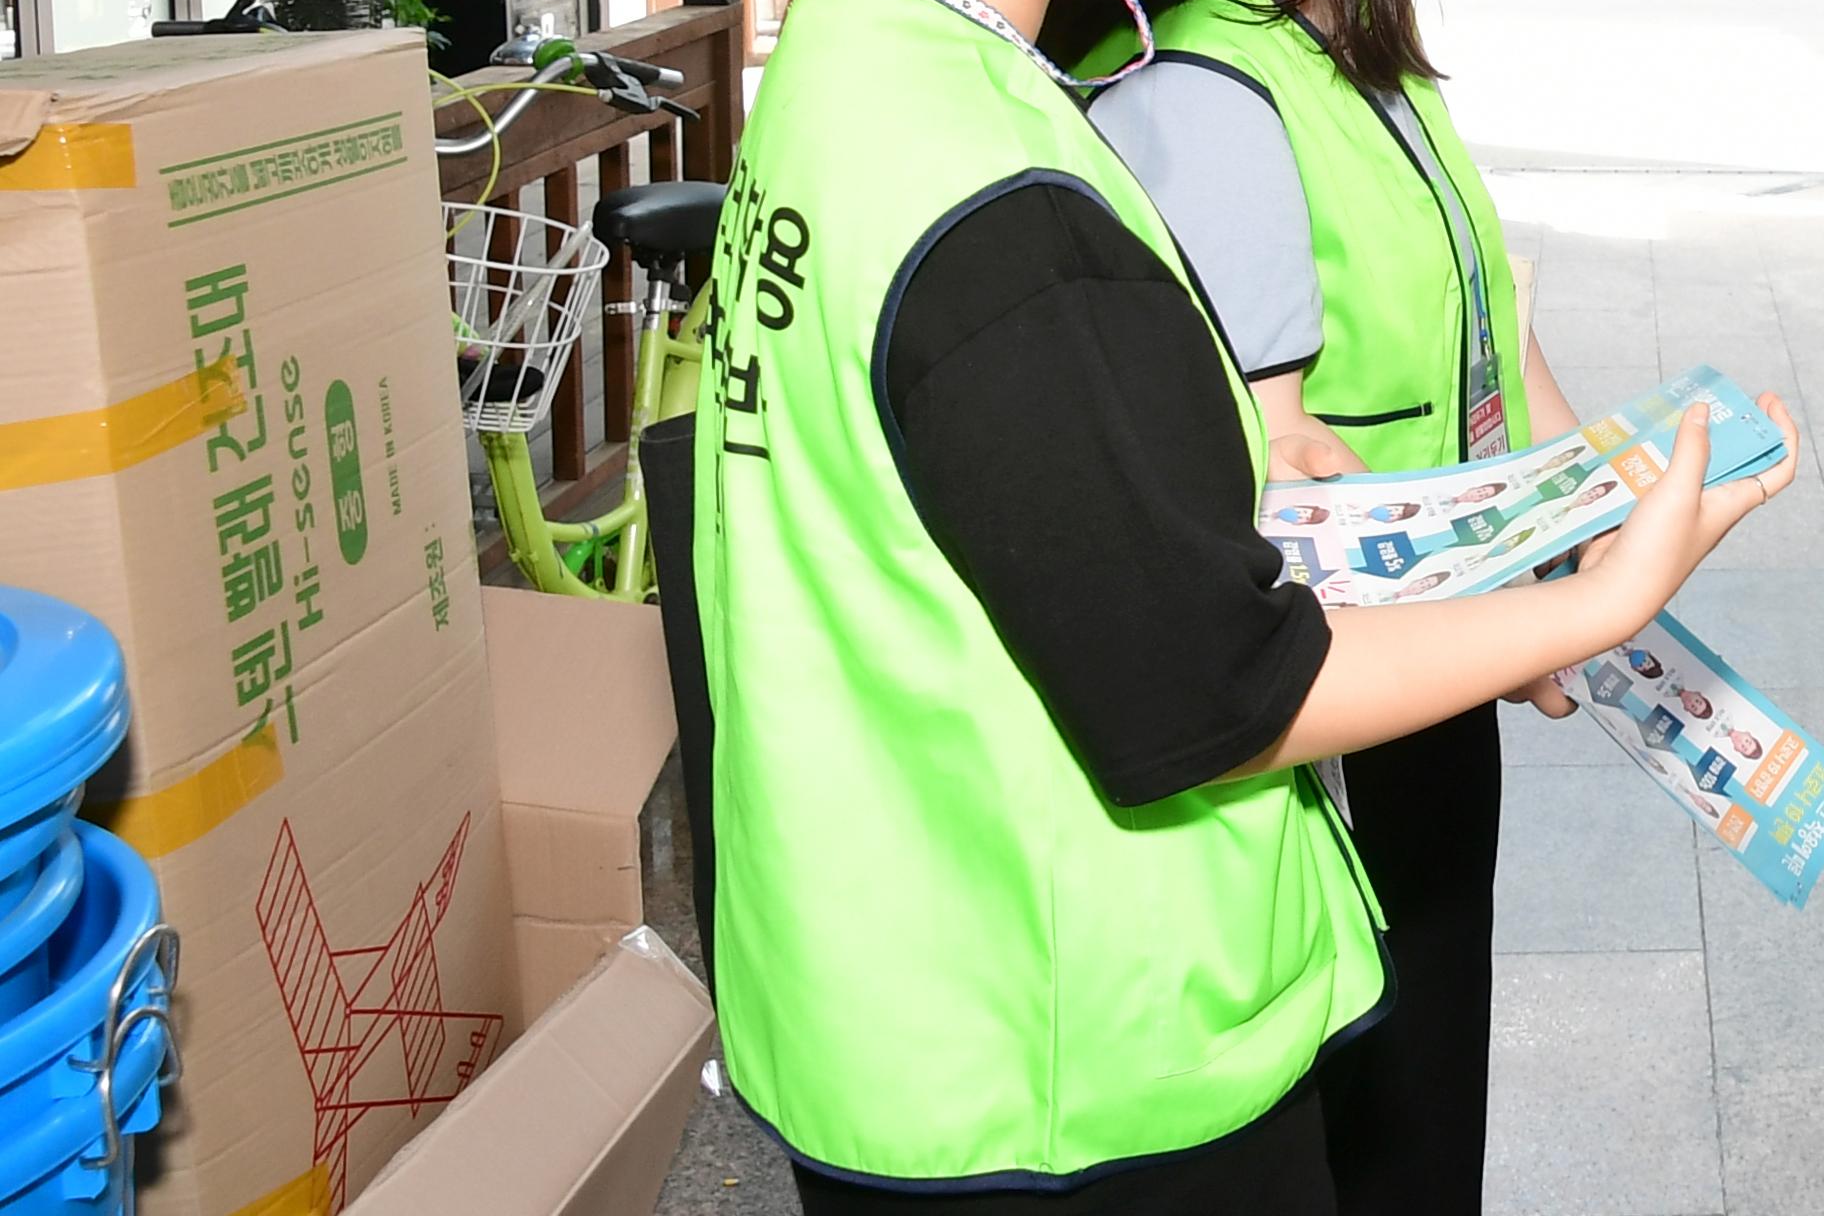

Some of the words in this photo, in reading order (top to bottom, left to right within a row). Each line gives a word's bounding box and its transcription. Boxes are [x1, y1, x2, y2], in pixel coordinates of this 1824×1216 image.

[184, 263, 269, 474] 건조대
[378, 375, 395, 440] KOREA
[211, 473, 285, 624] 빨래
[279, 354, 324, 632] Hi-sense
[387, 462, 403, 517] MADE
[427, 536, 450, 632] 제조원
